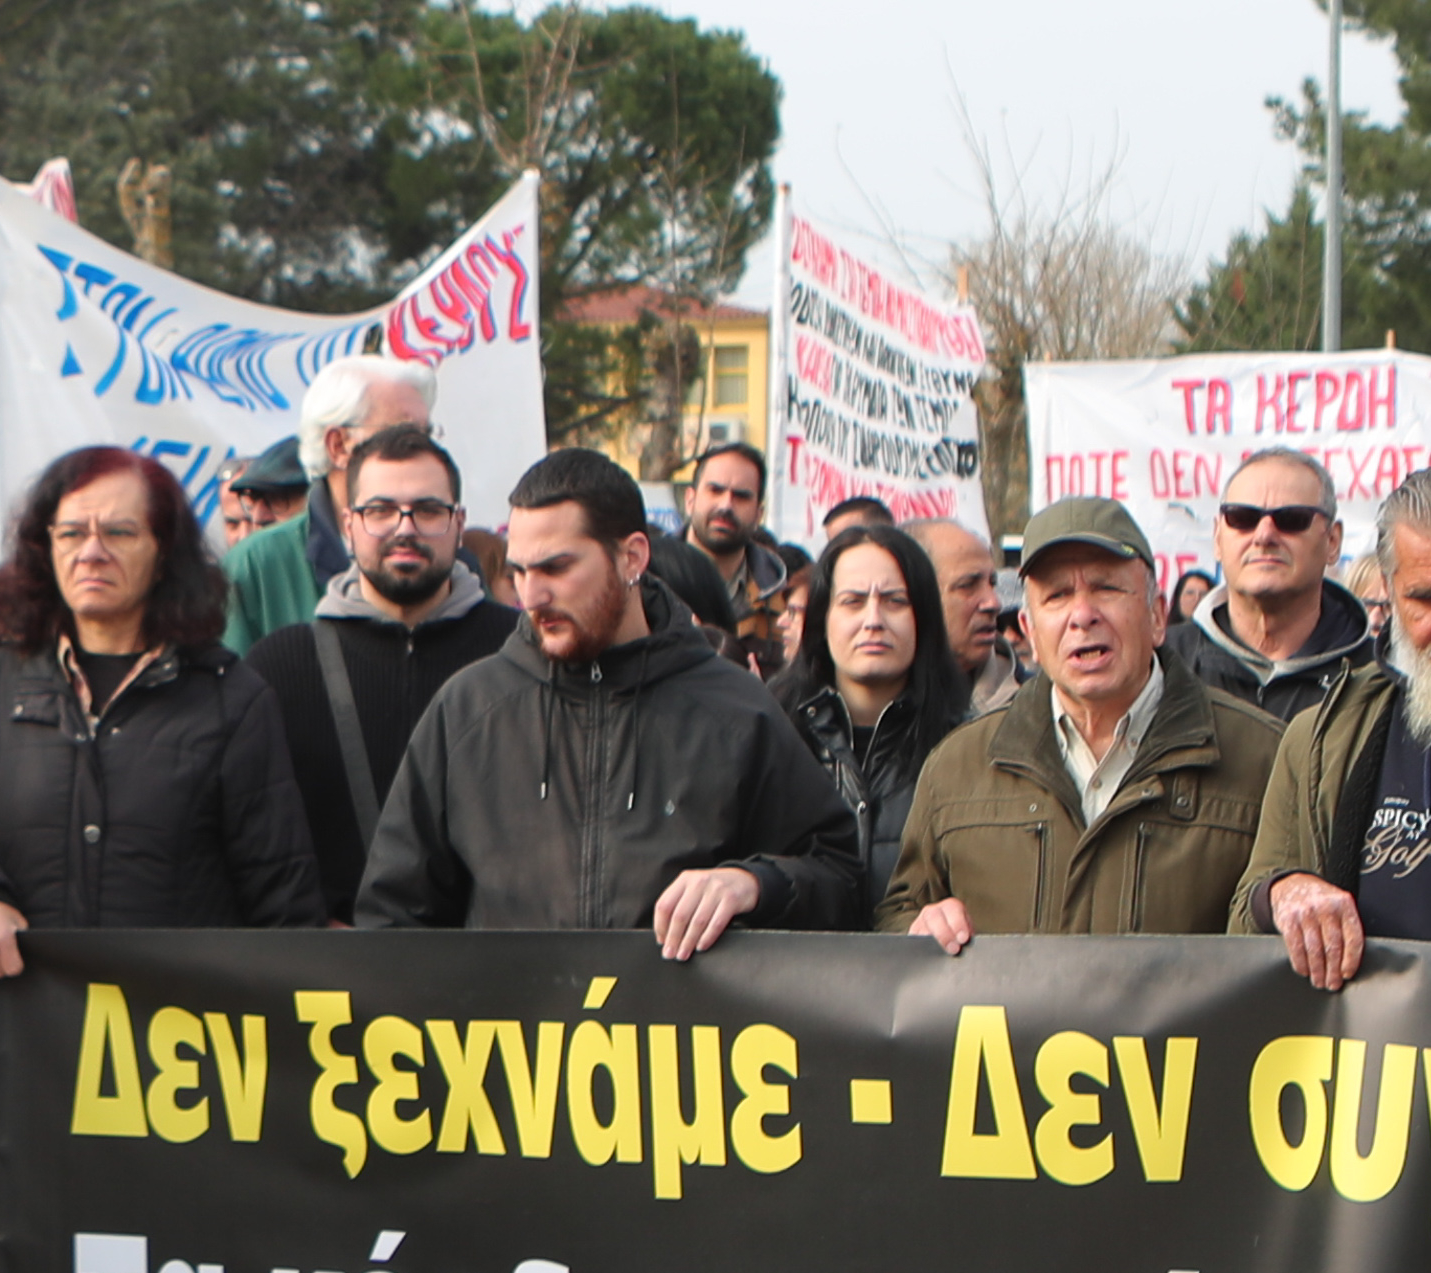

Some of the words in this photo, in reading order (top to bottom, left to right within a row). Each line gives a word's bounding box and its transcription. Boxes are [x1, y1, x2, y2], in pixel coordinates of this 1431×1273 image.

[1172, 378, 1233, 434] ΤΑ
[1254, 364, 1398, 432] ΚΕΡΔΗ
[1045, 450, 1130, 502] ΠΟΤΕ
[1149, 449, 1221, 500] ΔΕΝ
[71, 983, 268, 1143] Δεν
[293, 976, 803, 1201] ξεχνάμε
[850, 1078, 893, 1125] -
[940, 1004, 1197, 1188] Δεν
